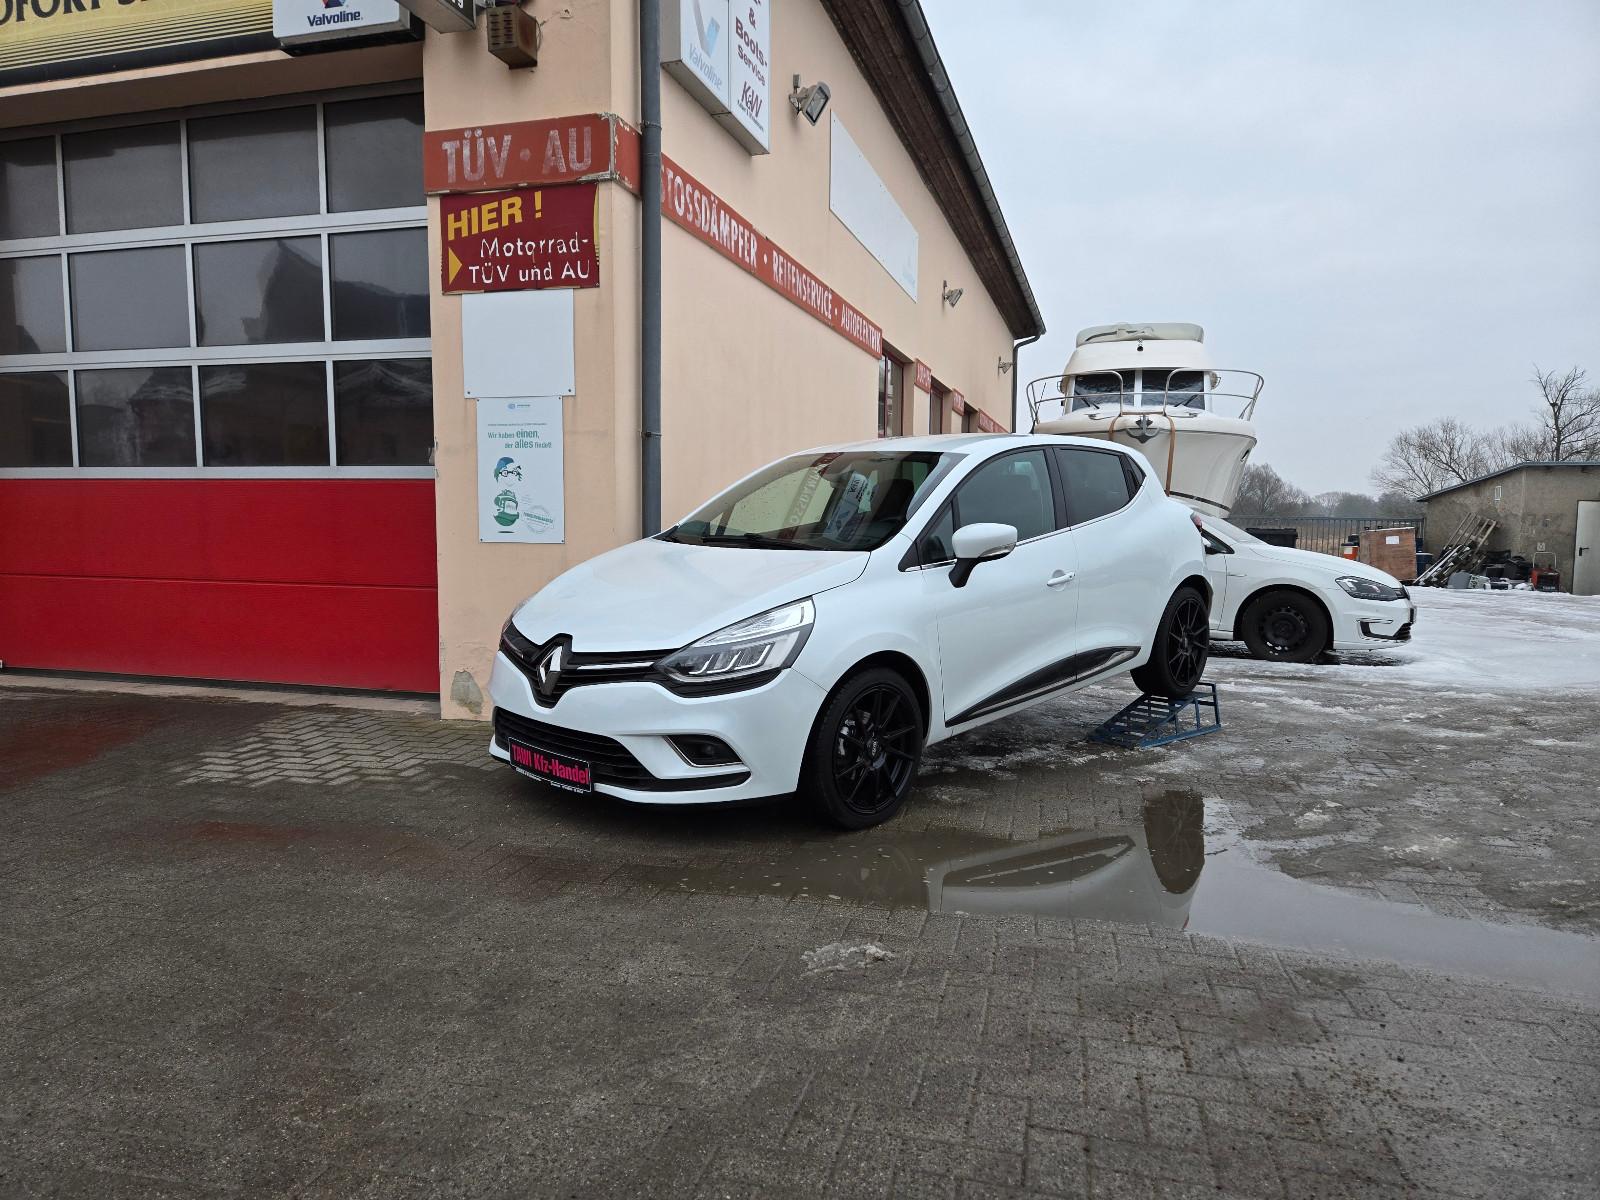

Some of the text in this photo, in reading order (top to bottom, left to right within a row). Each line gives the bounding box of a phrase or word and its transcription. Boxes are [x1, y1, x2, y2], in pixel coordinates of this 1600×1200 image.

[307, 10, 361, 27] Valvoline
[689, 43, 723, 88] Valvoline
[738, 44, 766, 87] Service
[441, 126, 592, 183] TÜV AU
[447, 196, 522, 240] HIER
[480, 232, 589, 258] Motorrad-
[661, 164, 757, 268] TOSSDÄMPFER
[772, 249, 832, 320] REIFENSERVICE
[469, 260, 590, 284] TÜV und AU
[514, 438, 534, 449] alles
